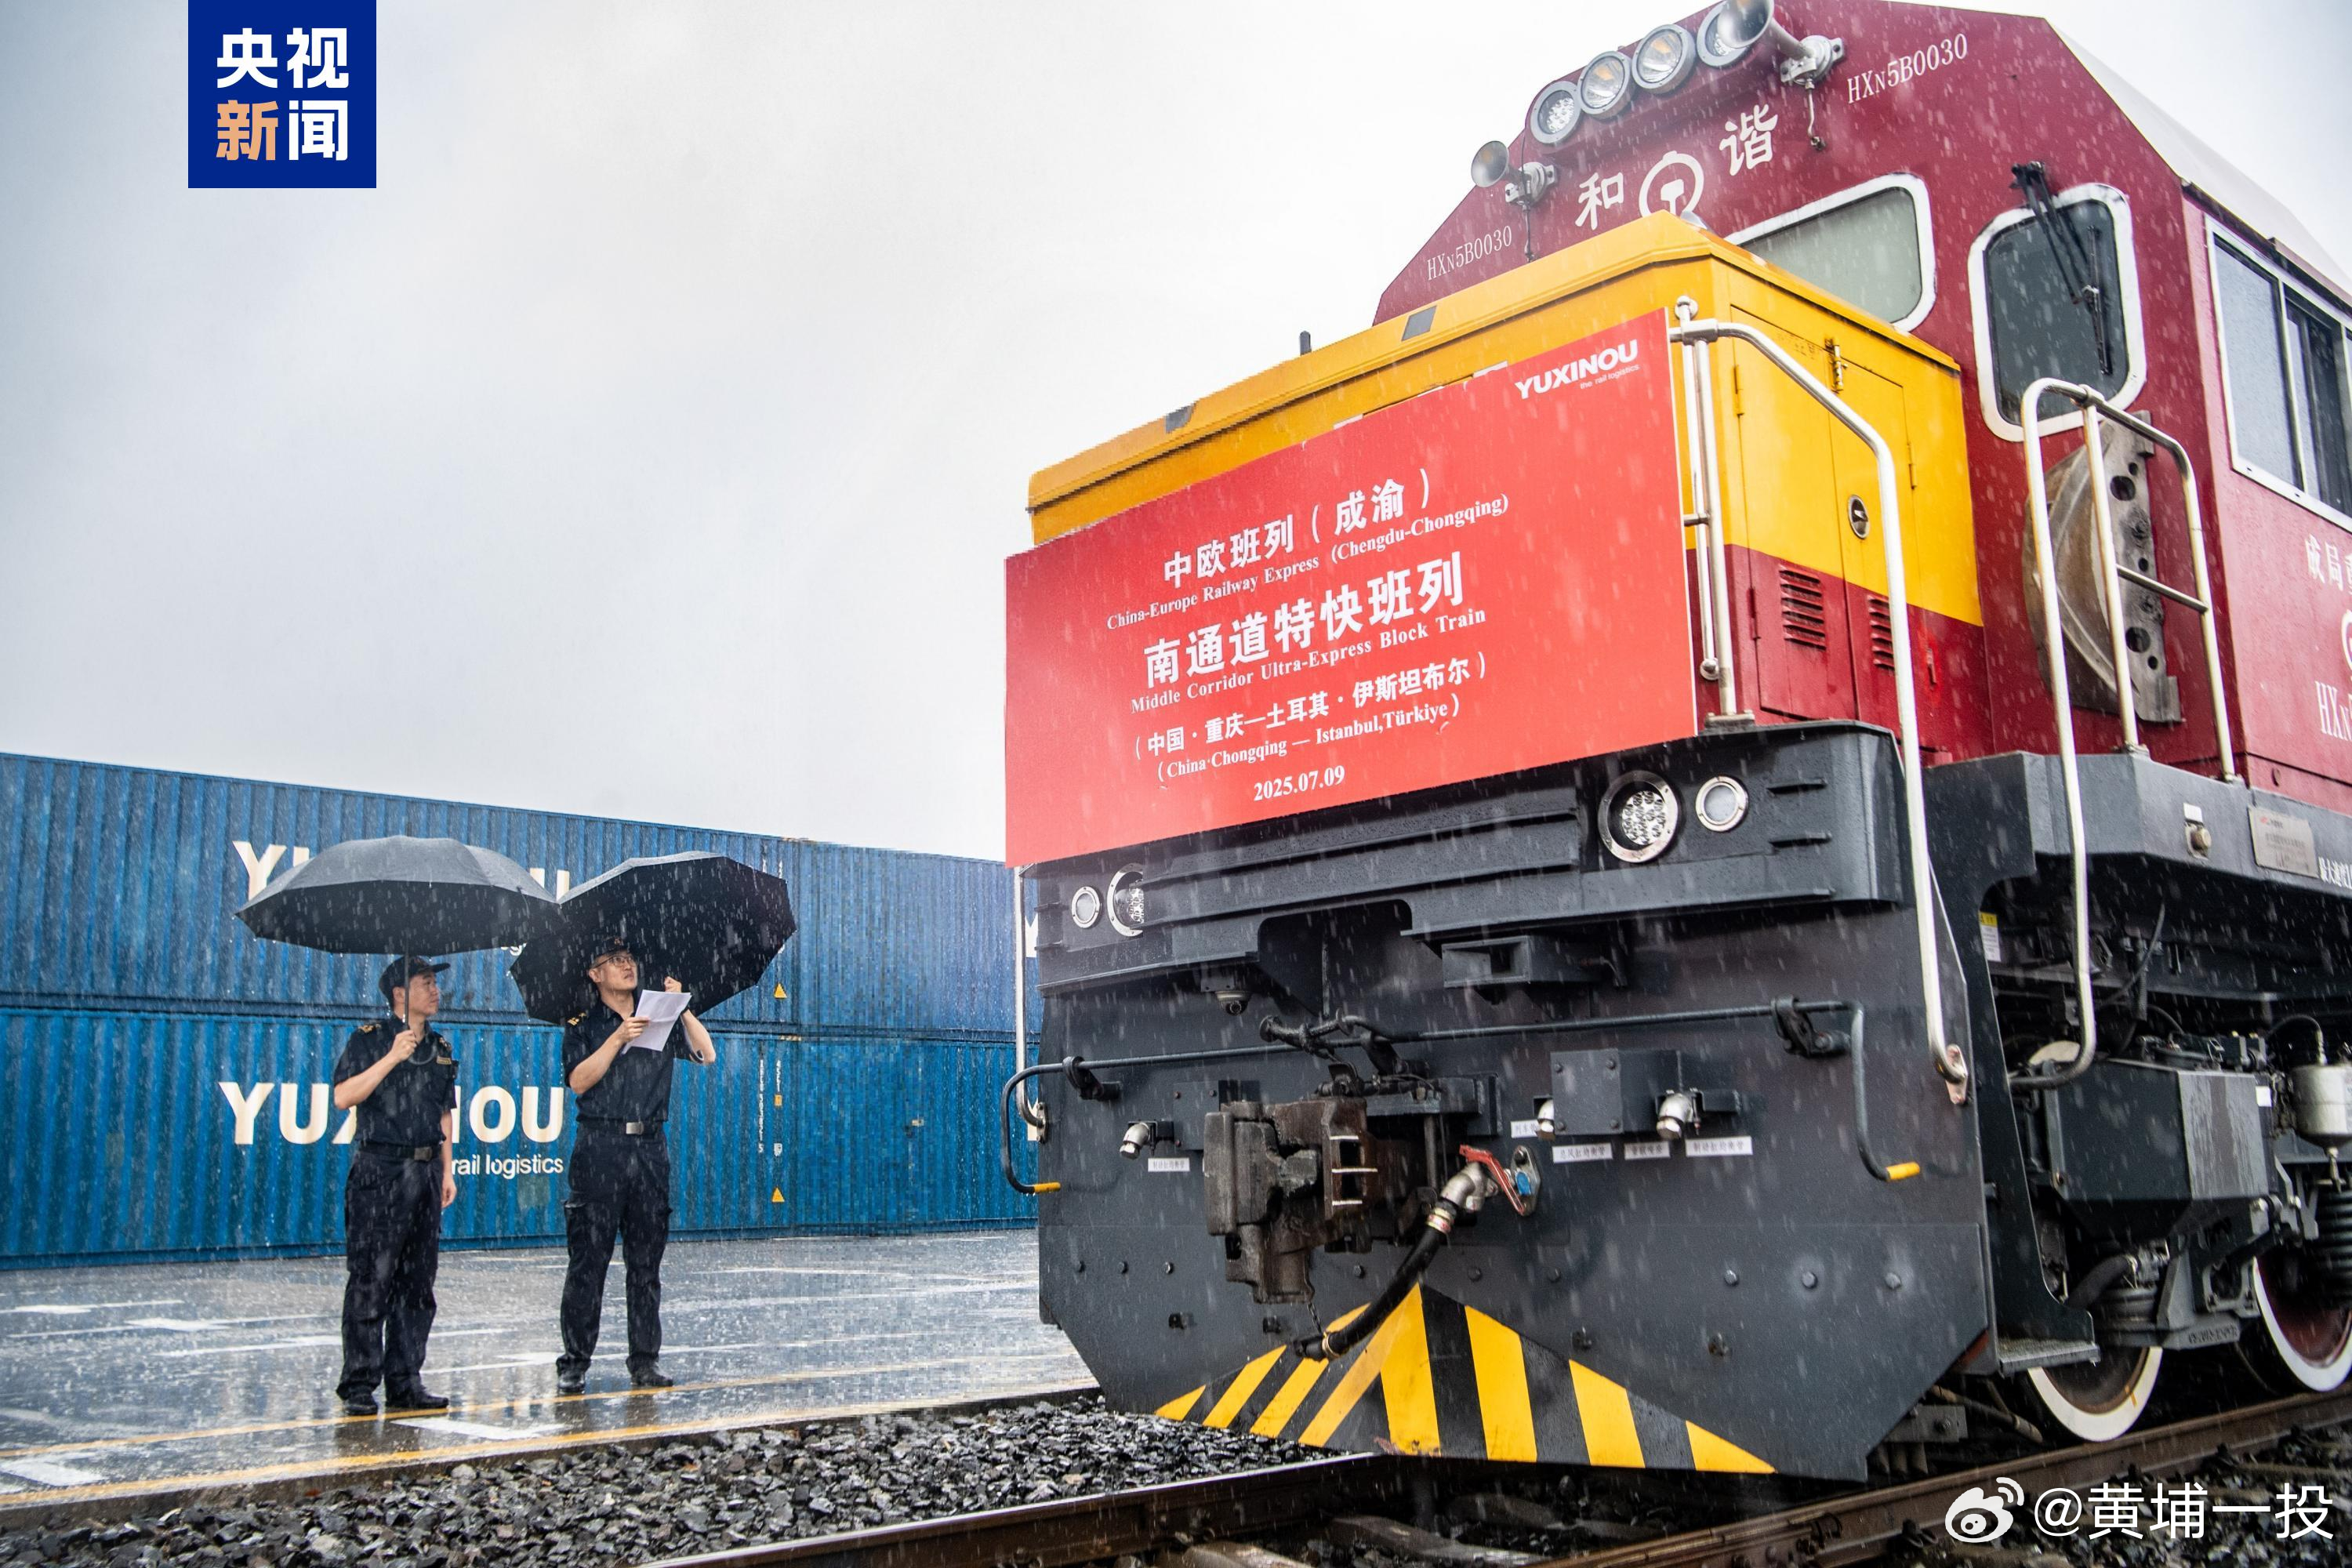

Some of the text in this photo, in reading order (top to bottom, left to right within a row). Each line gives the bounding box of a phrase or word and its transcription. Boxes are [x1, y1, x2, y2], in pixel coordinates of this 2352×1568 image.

[1575, 103, 1778, 230] 和 谐
[1515, 339, 1639, 400] YUXINOU
[1580, 364, 1640, 390] the rail logistics
[1106, 493, 1509, 630] China-Europe Railway Express (Chengdu-Chongqing)
[1144, 551, 1463, 689] 南通道特快班列
[1131, 608, 1486, 714] Middle Corridor Ultra-Express Block Train
[2315, 680, 2352, 742] HXN
[1254, 764, 1345, 801] 2025.07.09
[452, 1154, 564, 1179] rail logistics
